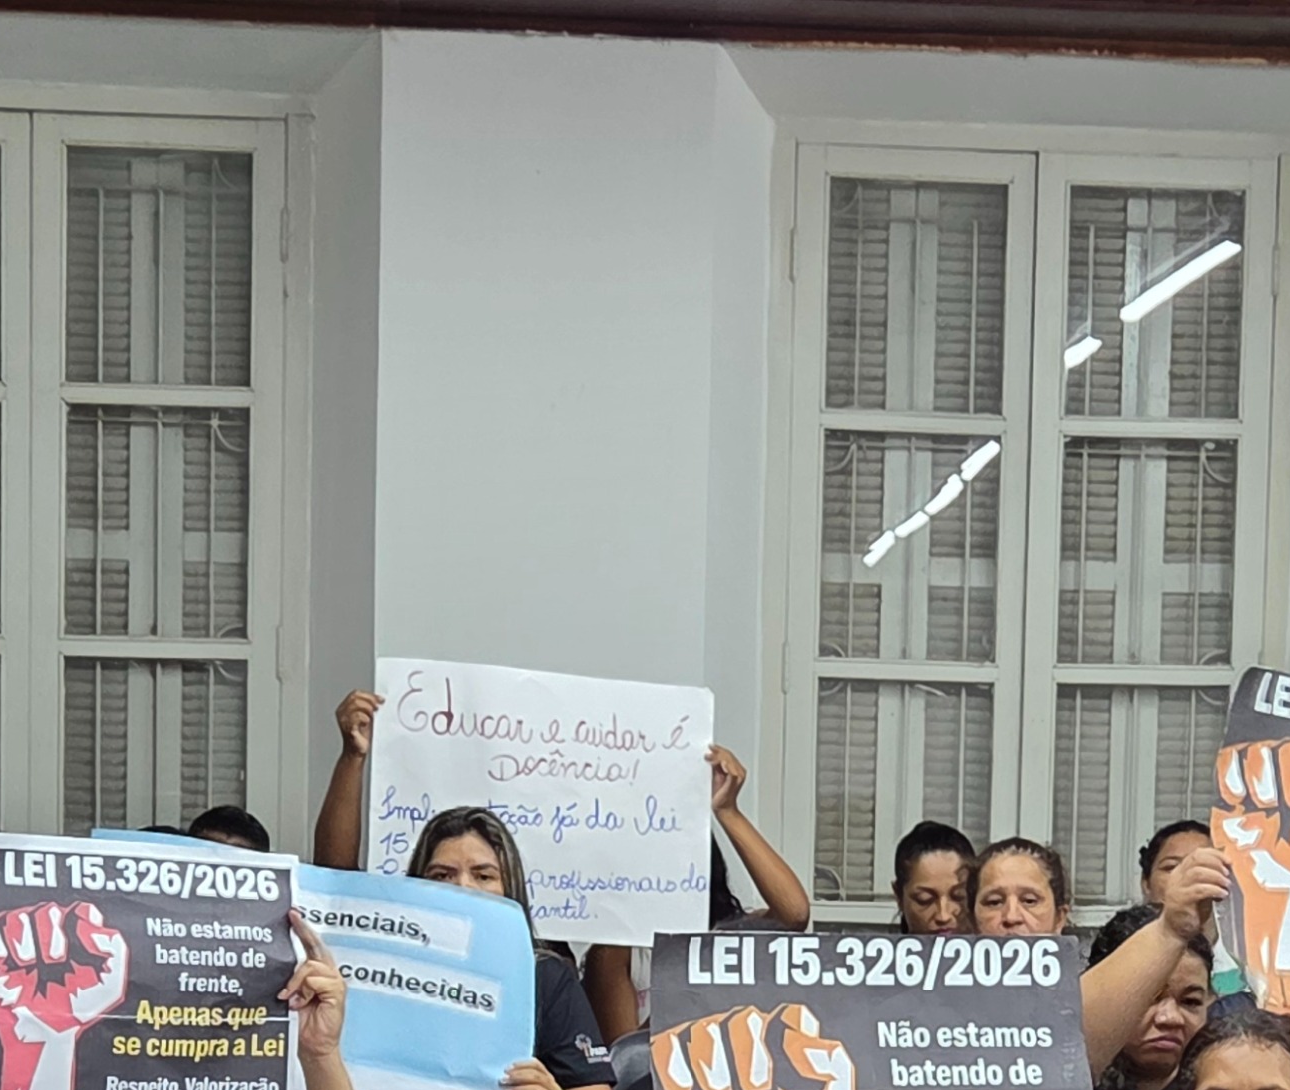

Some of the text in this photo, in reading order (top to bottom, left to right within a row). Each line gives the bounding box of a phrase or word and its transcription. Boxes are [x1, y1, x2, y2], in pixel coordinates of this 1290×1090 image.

[398, 671, 690, 752] Educar e cuidar é
[585, 798, 625, 832] da
[4, 851, 280, 902] LEI 15.326/2026
[146, 918, 273, 944] Não estamos
[156, 945, 267, 969] batendo de
[688, 936, 1061, 990] LEI 15.326/2026
[178, 973, 244, 997] frente,
[136, 1000, 268, 1030] Apenas que
[112, 1033, 285, 1062] se cumpra a Lei
[877, 1021, 1053, 1048] Não estamos
[891, 1058, 1043, 1087] batendo de
